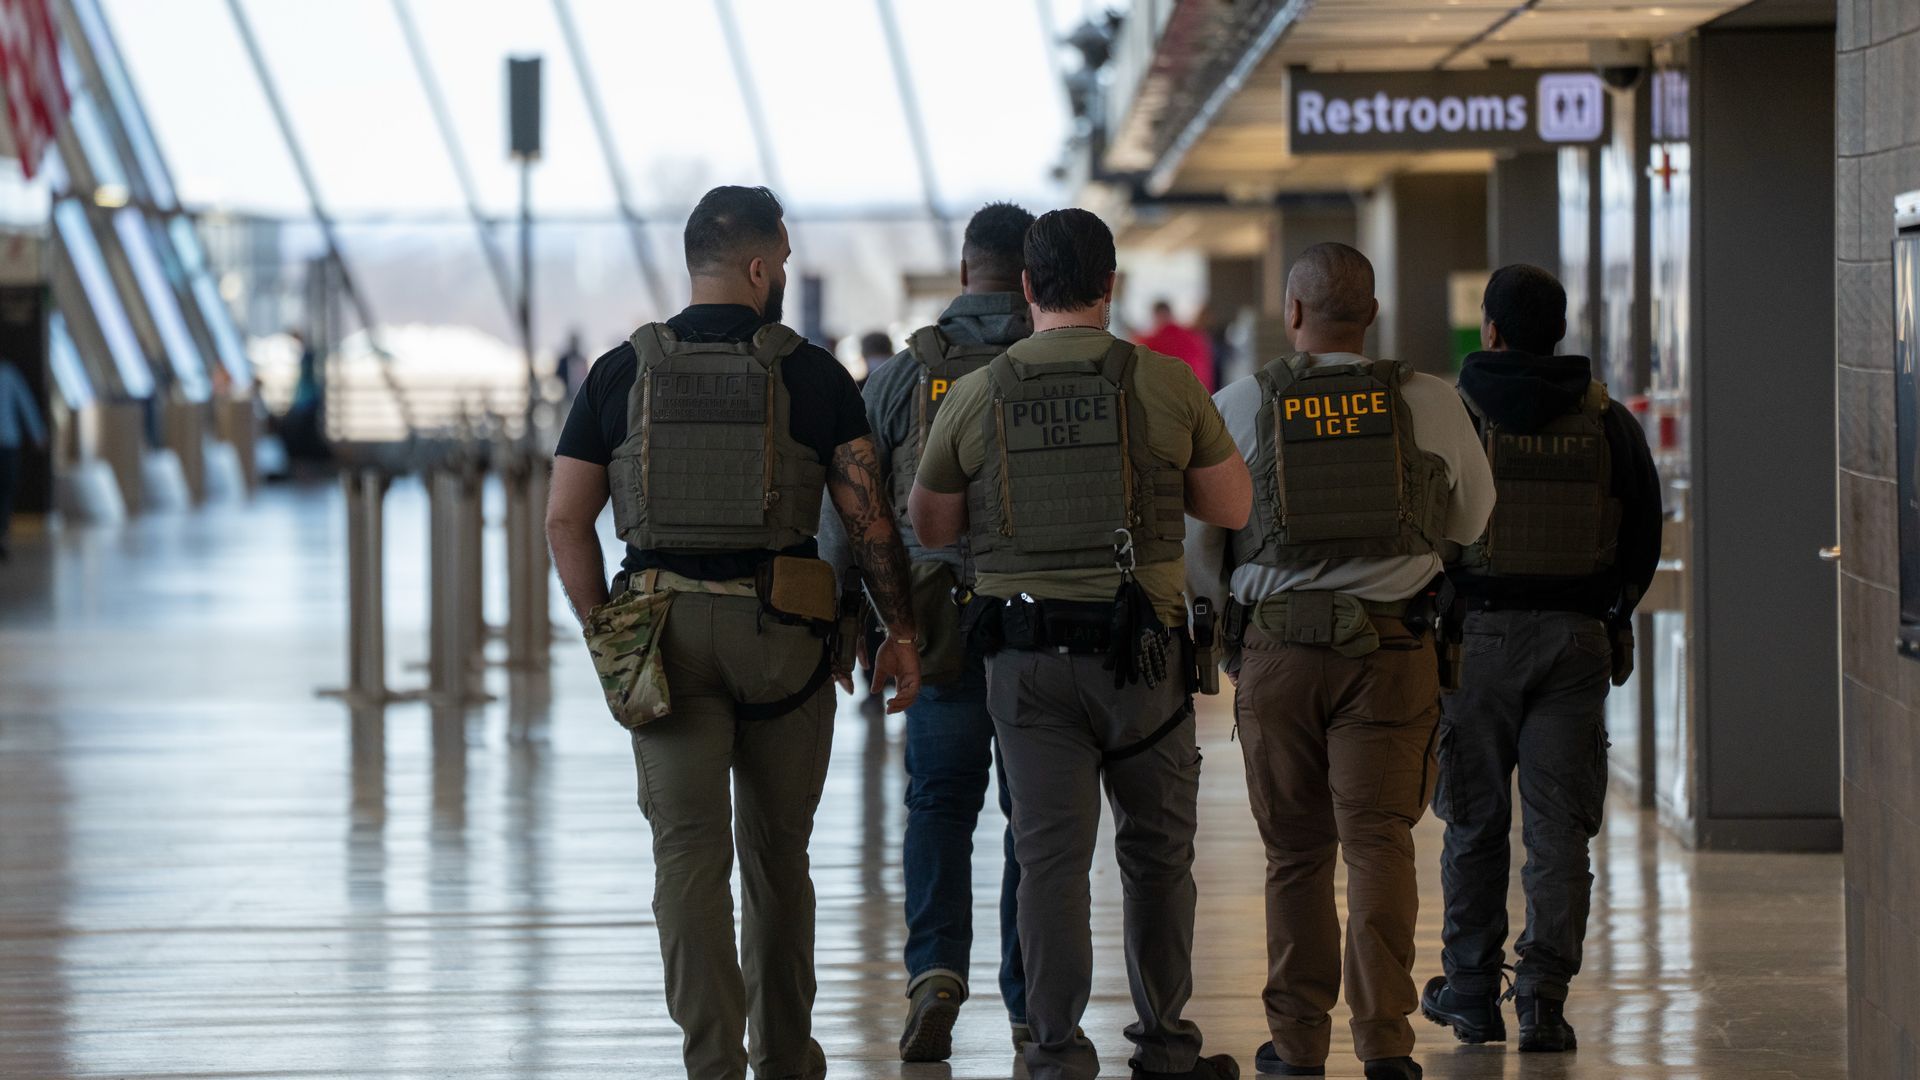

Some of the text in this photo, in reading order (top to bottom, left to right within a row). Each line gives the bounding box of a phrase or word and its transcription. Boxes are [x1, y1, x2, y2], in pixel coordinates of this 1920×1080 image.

[1297, 90, 1527, 134] Restrooms
[656, 375, 761, 397] POLICE
[1013, 397, 1108, 427] POLICE
[1284, 392, 1387, 420] POLICE
[1043, 424, 1081, 446] ICE
[1315, 417, 1360, 436] ICE
